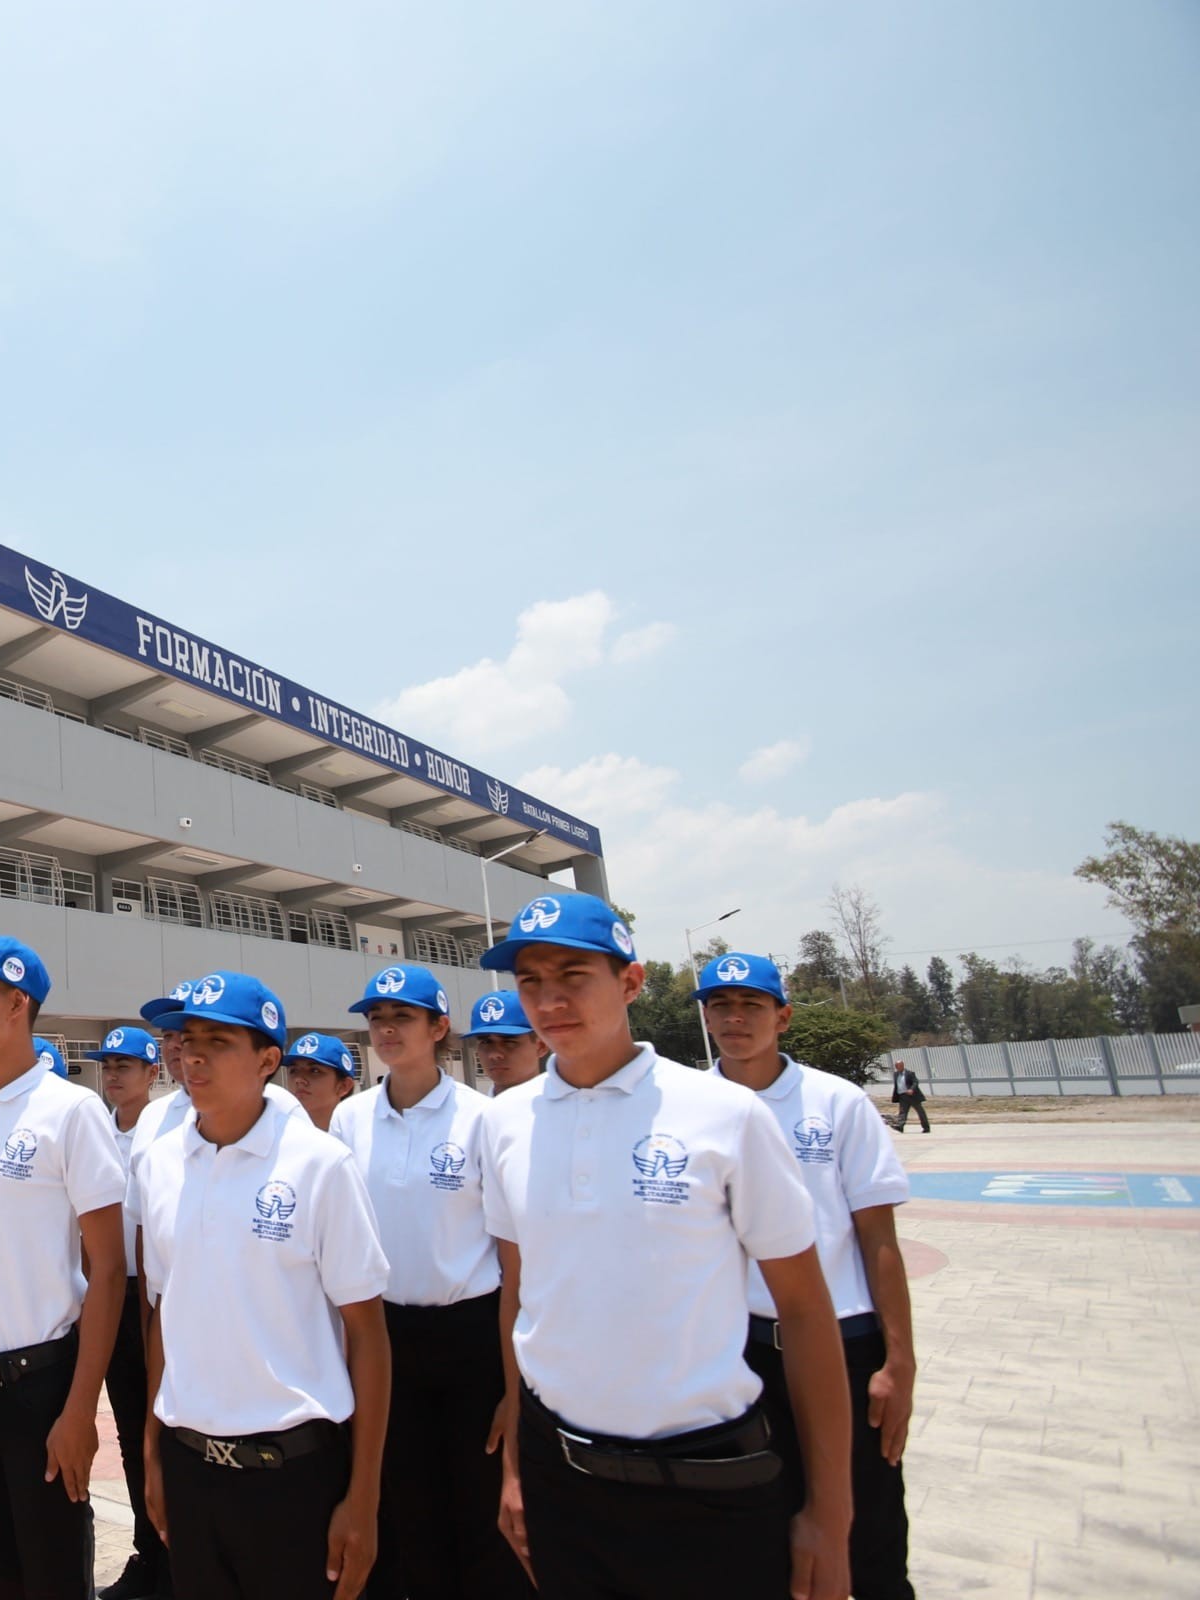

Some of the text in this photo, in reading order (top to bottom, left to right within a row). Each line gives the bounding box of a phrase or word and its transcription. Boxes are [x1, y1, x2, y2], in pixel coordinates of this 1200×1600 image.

[136, 616, 471, 796] FORMACIÓN INTEGRIDAD HONOR
[522, 801, 551, 825] BATALLÓN
